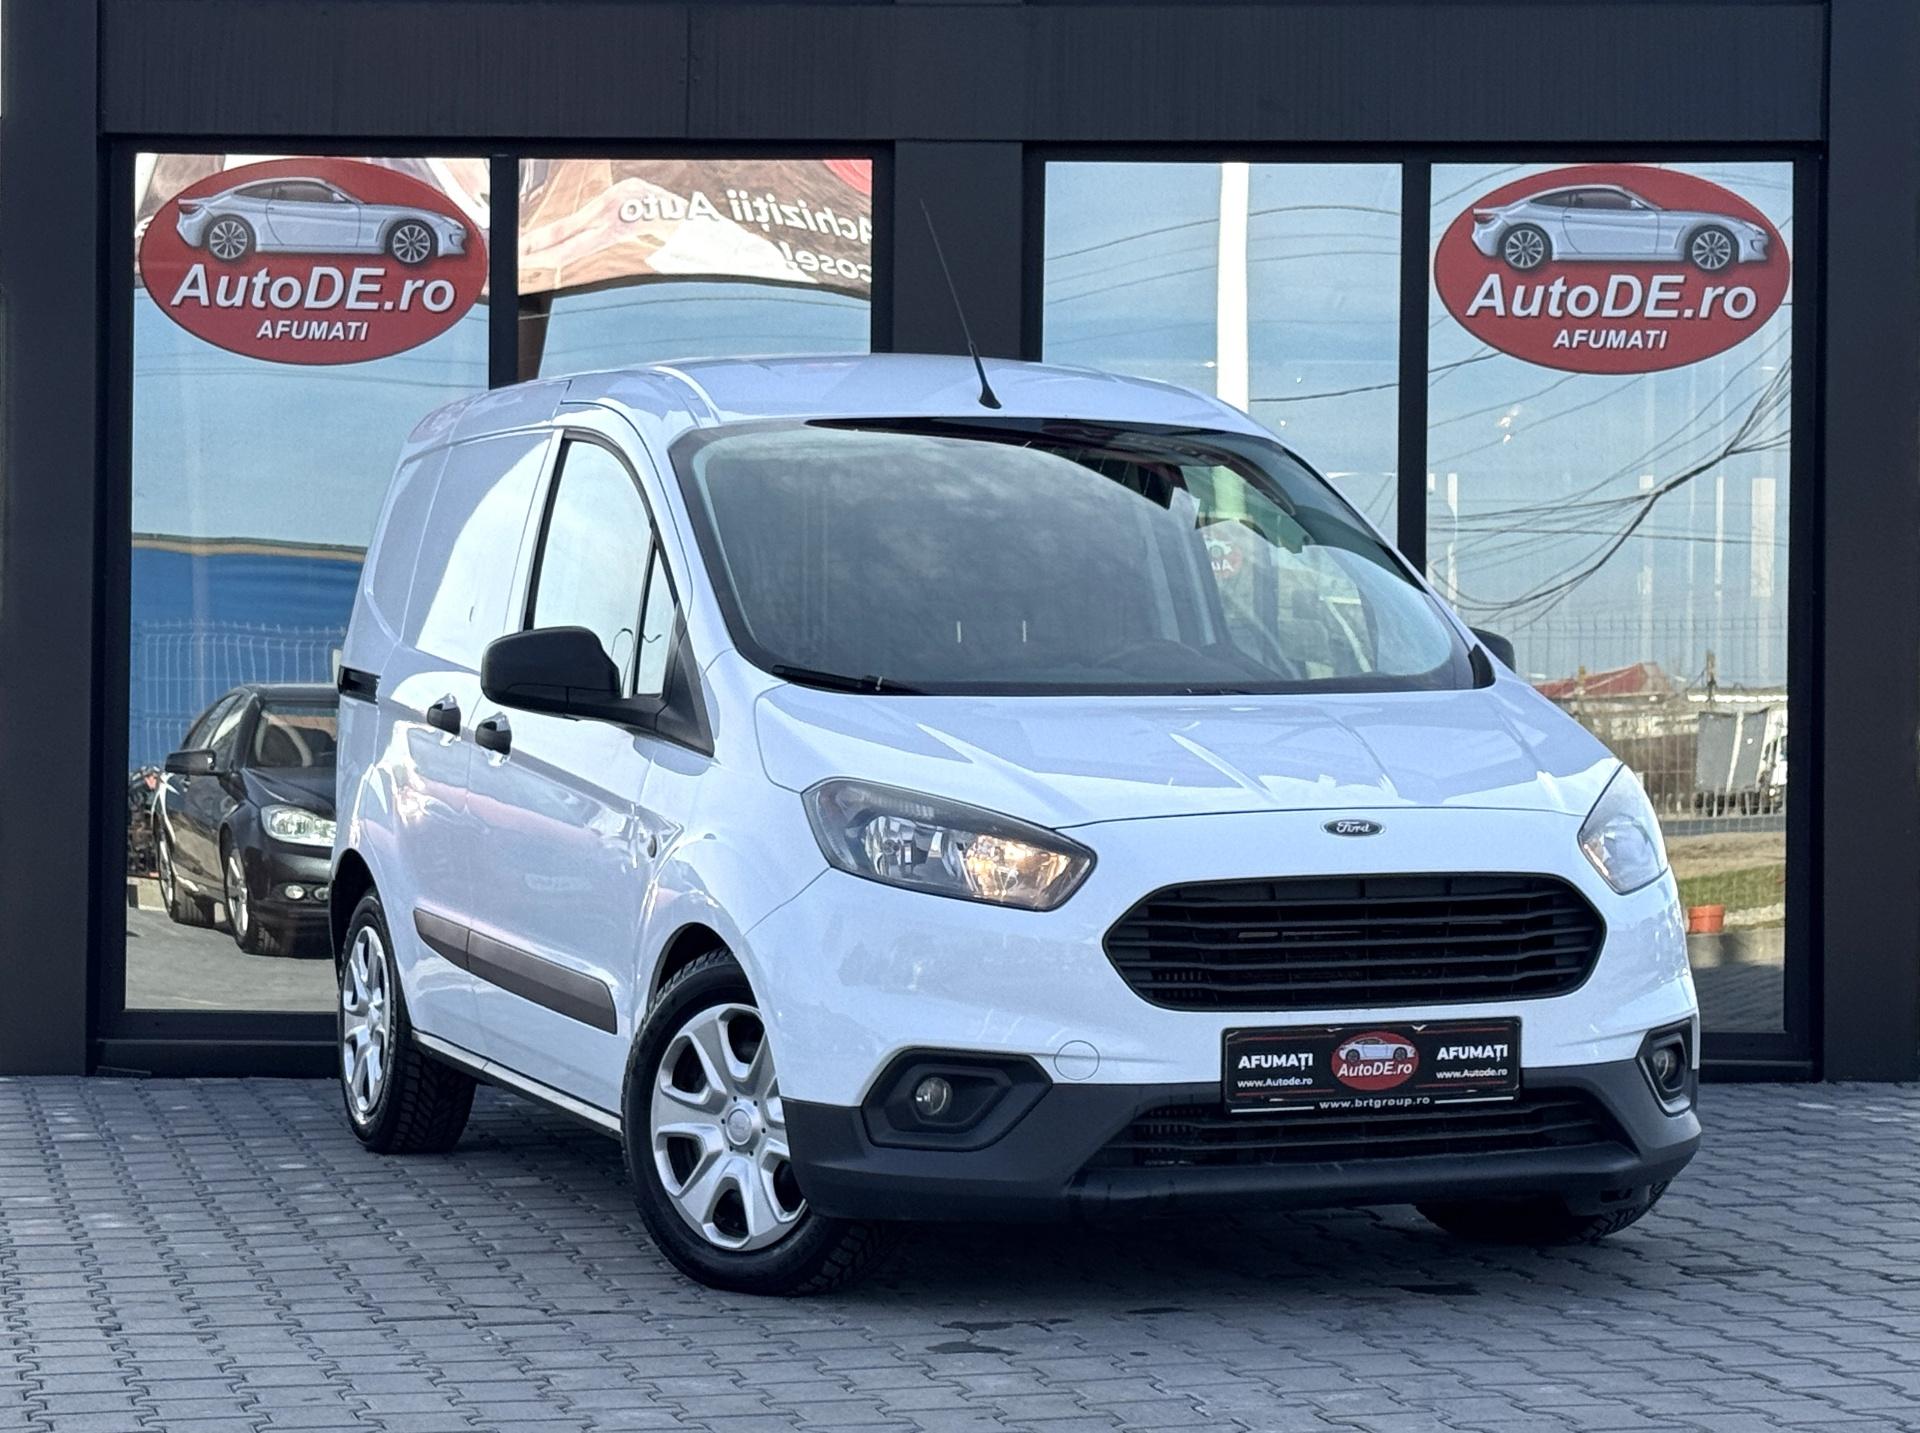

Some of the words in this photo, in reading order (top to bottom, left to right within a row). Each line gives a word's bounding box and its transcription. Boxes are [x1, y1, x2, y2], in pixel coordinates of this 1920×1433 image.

[170, 263, 456, 312] AutoDE.ro
[1466, 273, 1757, 320] AutoDE.ro
[256, 320, 369, 341] AFUMATI
[1553, 329, 1668, 349] AFUMATI
[1336, 821, 1370, 833] Ford
[1337, 1061, 1413, 1078] AutoDE.ro
[1436, 1067, 1508, 1079] www.Autode.ro
[1237, 1076, 1313, 1088] www.Autode.ro
[1319, 1096, 1430, 1110] www.brtgroup.ro
